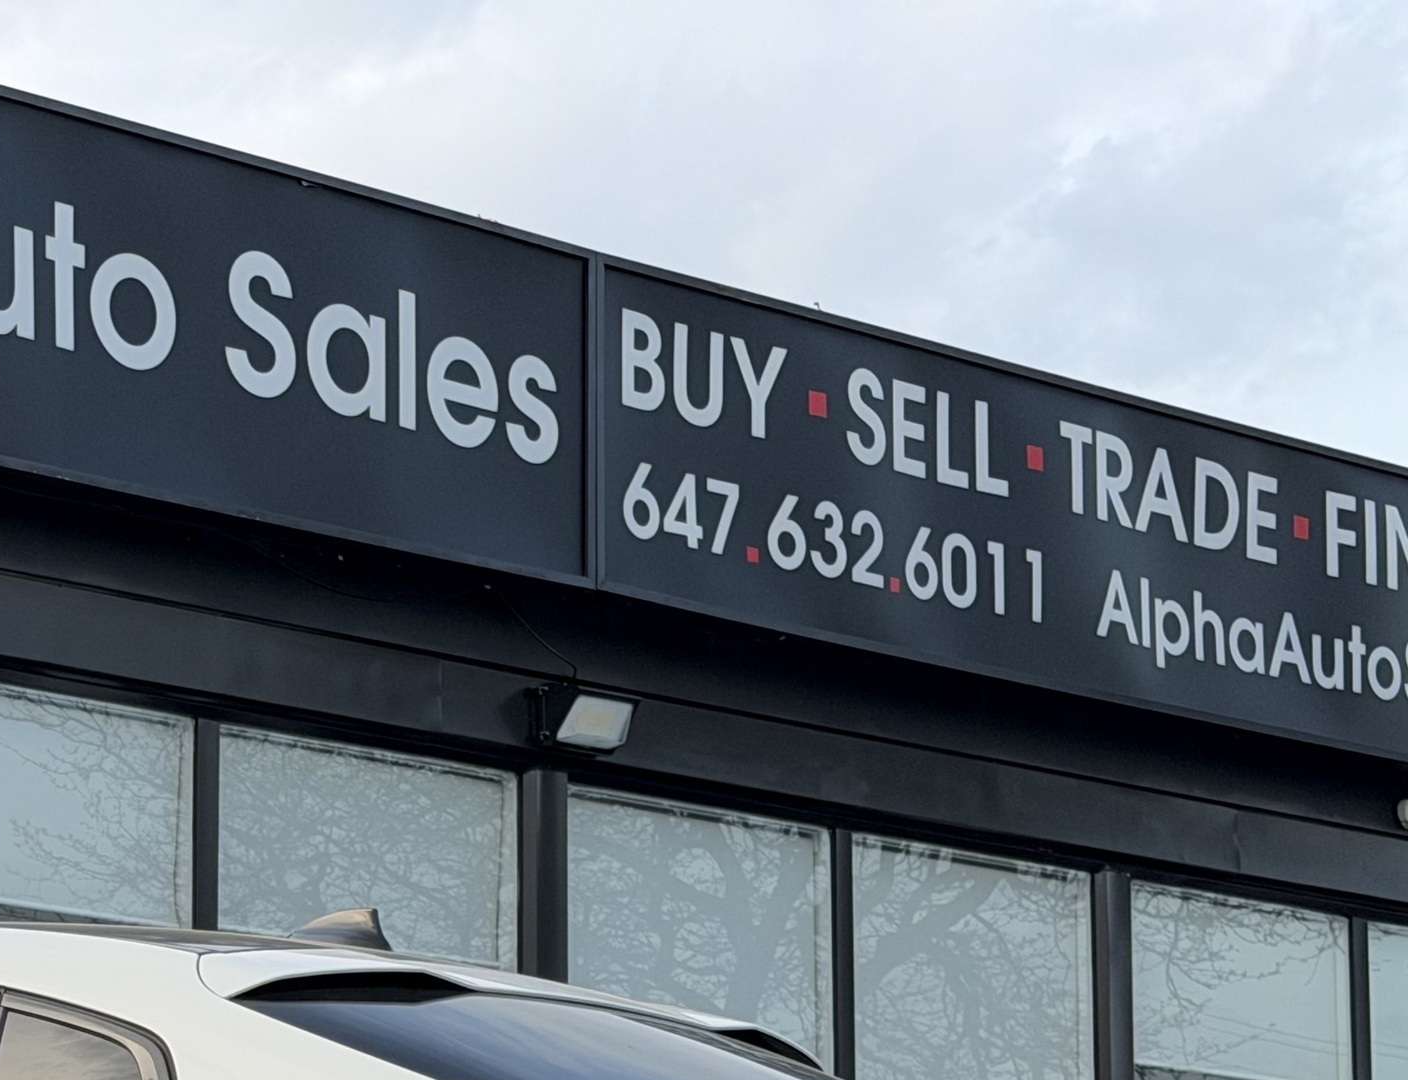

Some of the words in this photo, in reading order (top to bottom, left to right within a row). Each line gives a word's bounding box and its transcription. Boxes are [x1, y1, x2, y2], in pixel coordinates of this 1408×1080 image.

[225, 250, 559, 464] Sales
[621, 307, 788, 439] BUY
[846, 367, 1009, 497] SELL
[1059, 420, 1278, 565] TRADE
[623, 462, 1042, 623] 647.632.6011
[1096, 569, 1408, 702] AlphaAuto
